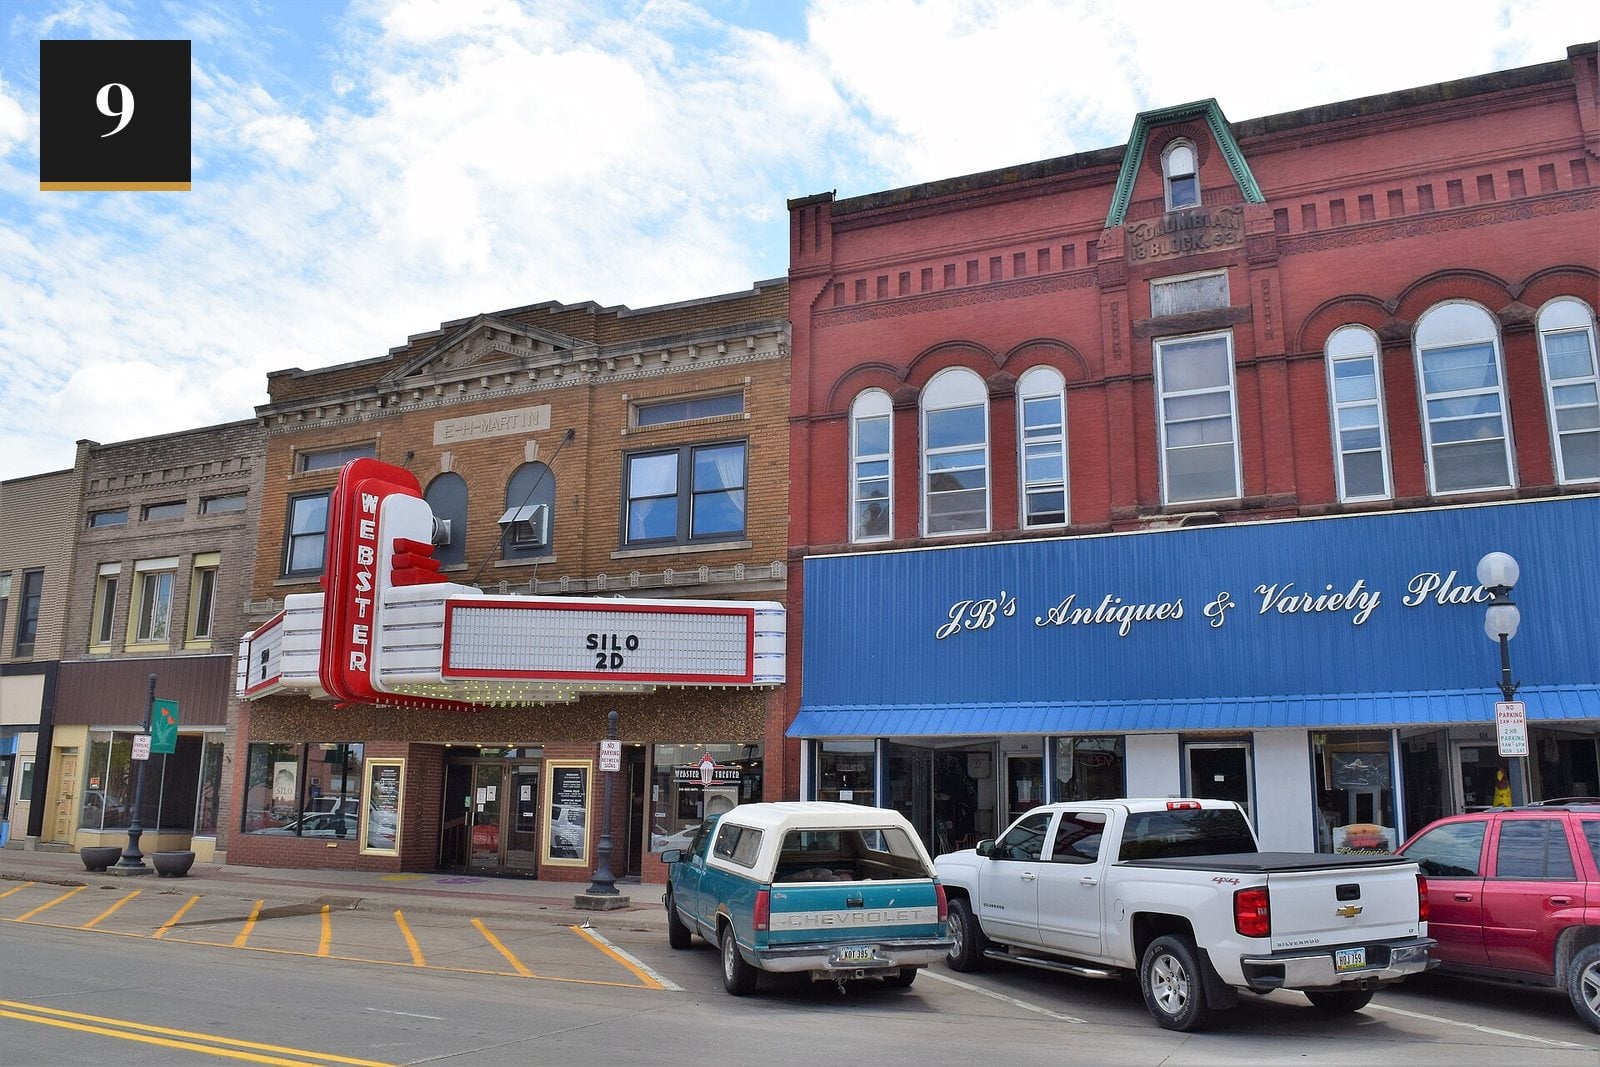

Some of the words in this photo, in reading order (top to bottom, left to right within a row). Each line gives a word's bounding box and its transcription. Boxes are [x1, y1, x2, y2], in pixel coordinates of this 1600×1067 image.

[1129, 207, 1242, 247] COLUMBIAN
[349, 493, 379, 672] WEBSTER
[935, 590, 1016, 639] JB's
[1035, 593, 1183, 636] Antiques
[1203, 591, 1235, 628] &
[1254, 579, 1381, 625] Variety
[1402, 570, 1496, 607] Plac
[586, 633, 639, 651] SILO
[595, 652, 624, 669] 2D
[675, 769, 700, 778] WEBSTER
[715, 770, 740, 779] THEATER
[276, 786, 293, 795] SILO
[788, 909, 923, 927] CHEVROLET
